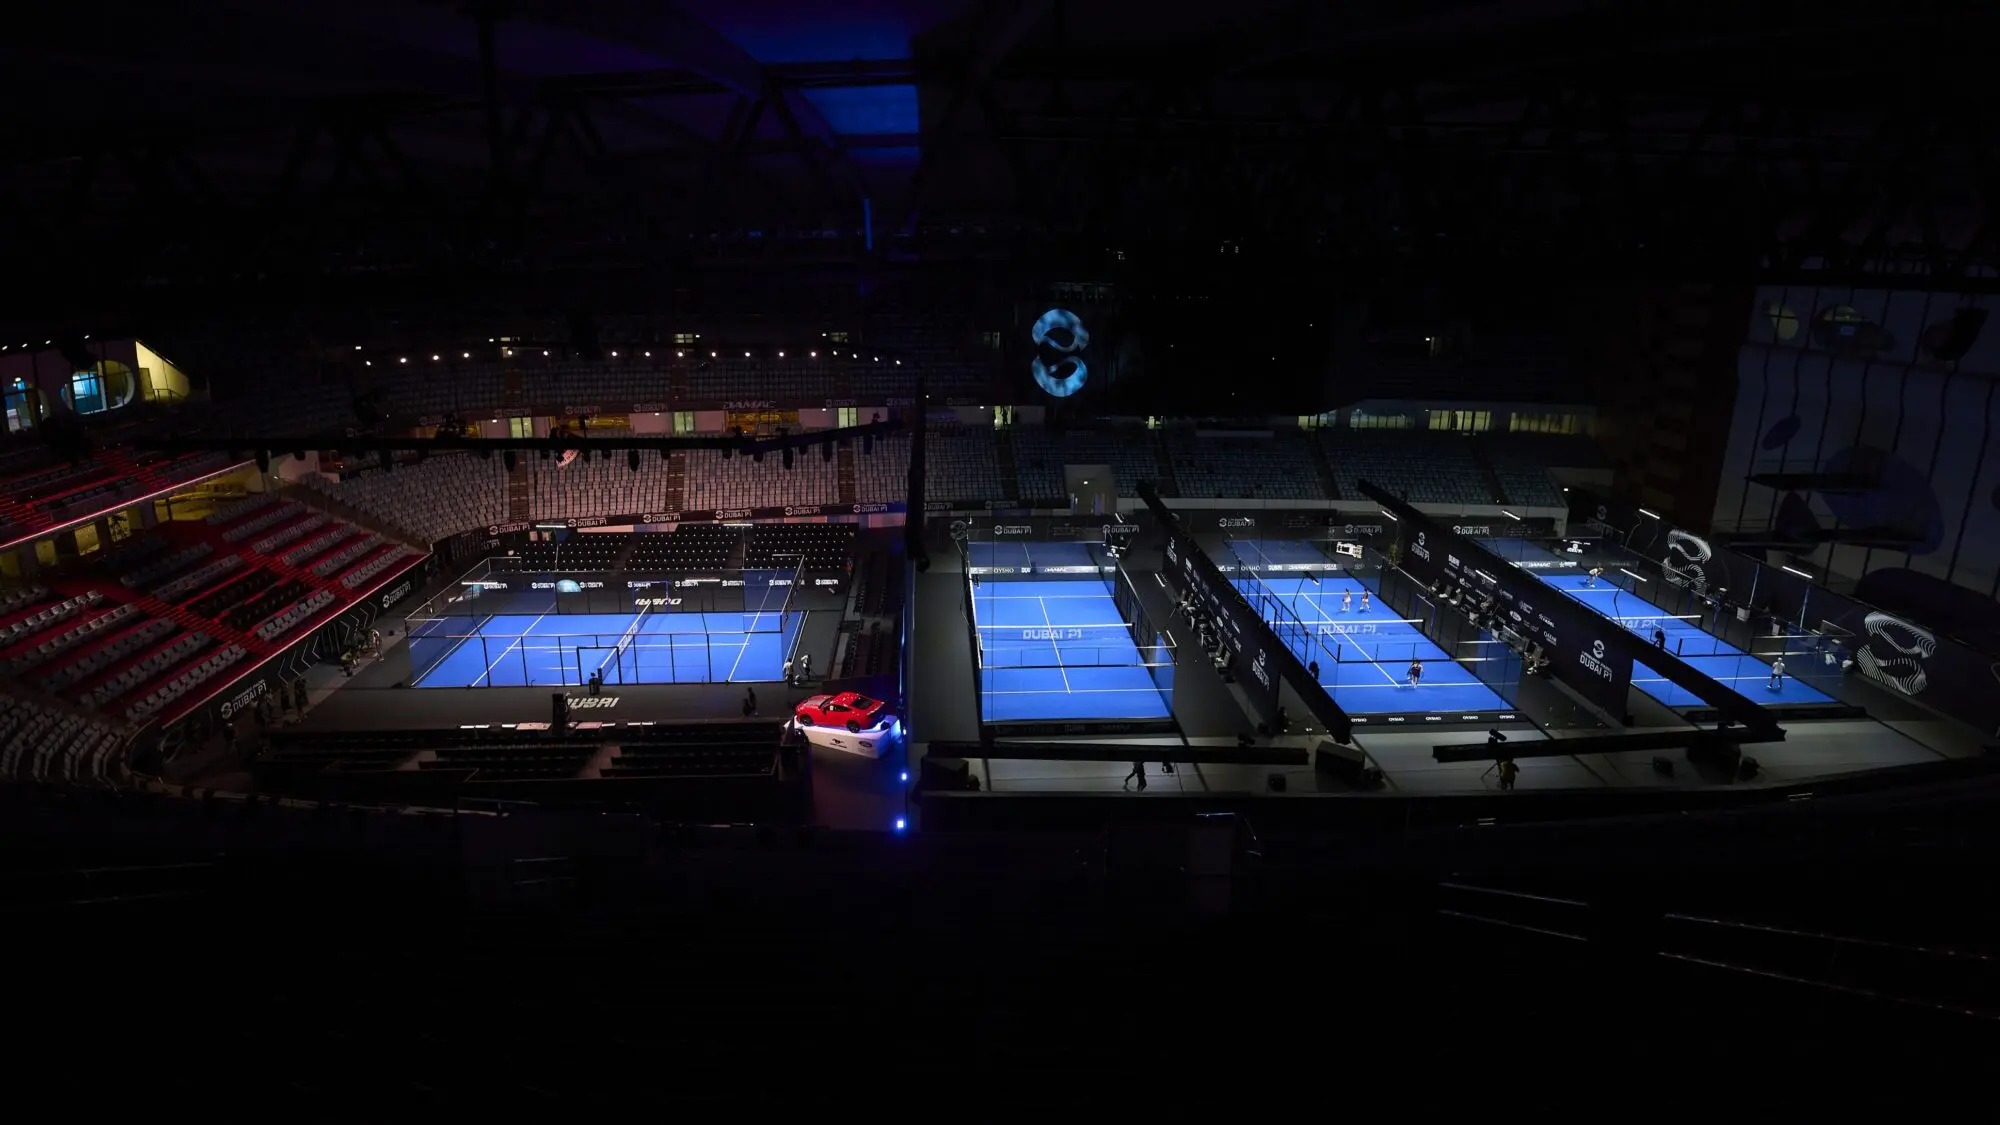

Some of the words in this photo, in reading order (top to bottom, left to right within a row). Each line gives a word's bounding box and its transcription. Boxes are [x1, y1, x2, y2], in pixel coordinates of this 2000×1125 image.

[1023, 629, 1063, 640] DUBAI
[1067, 628, 1082, 639] P1
[1318, 624, 1360, 635] DUBAI
[1580, 654, 1602, 676] DUBAI
[232, 690, 257, 713] DUBAI
[567, 697, 620, 709] UBAI
